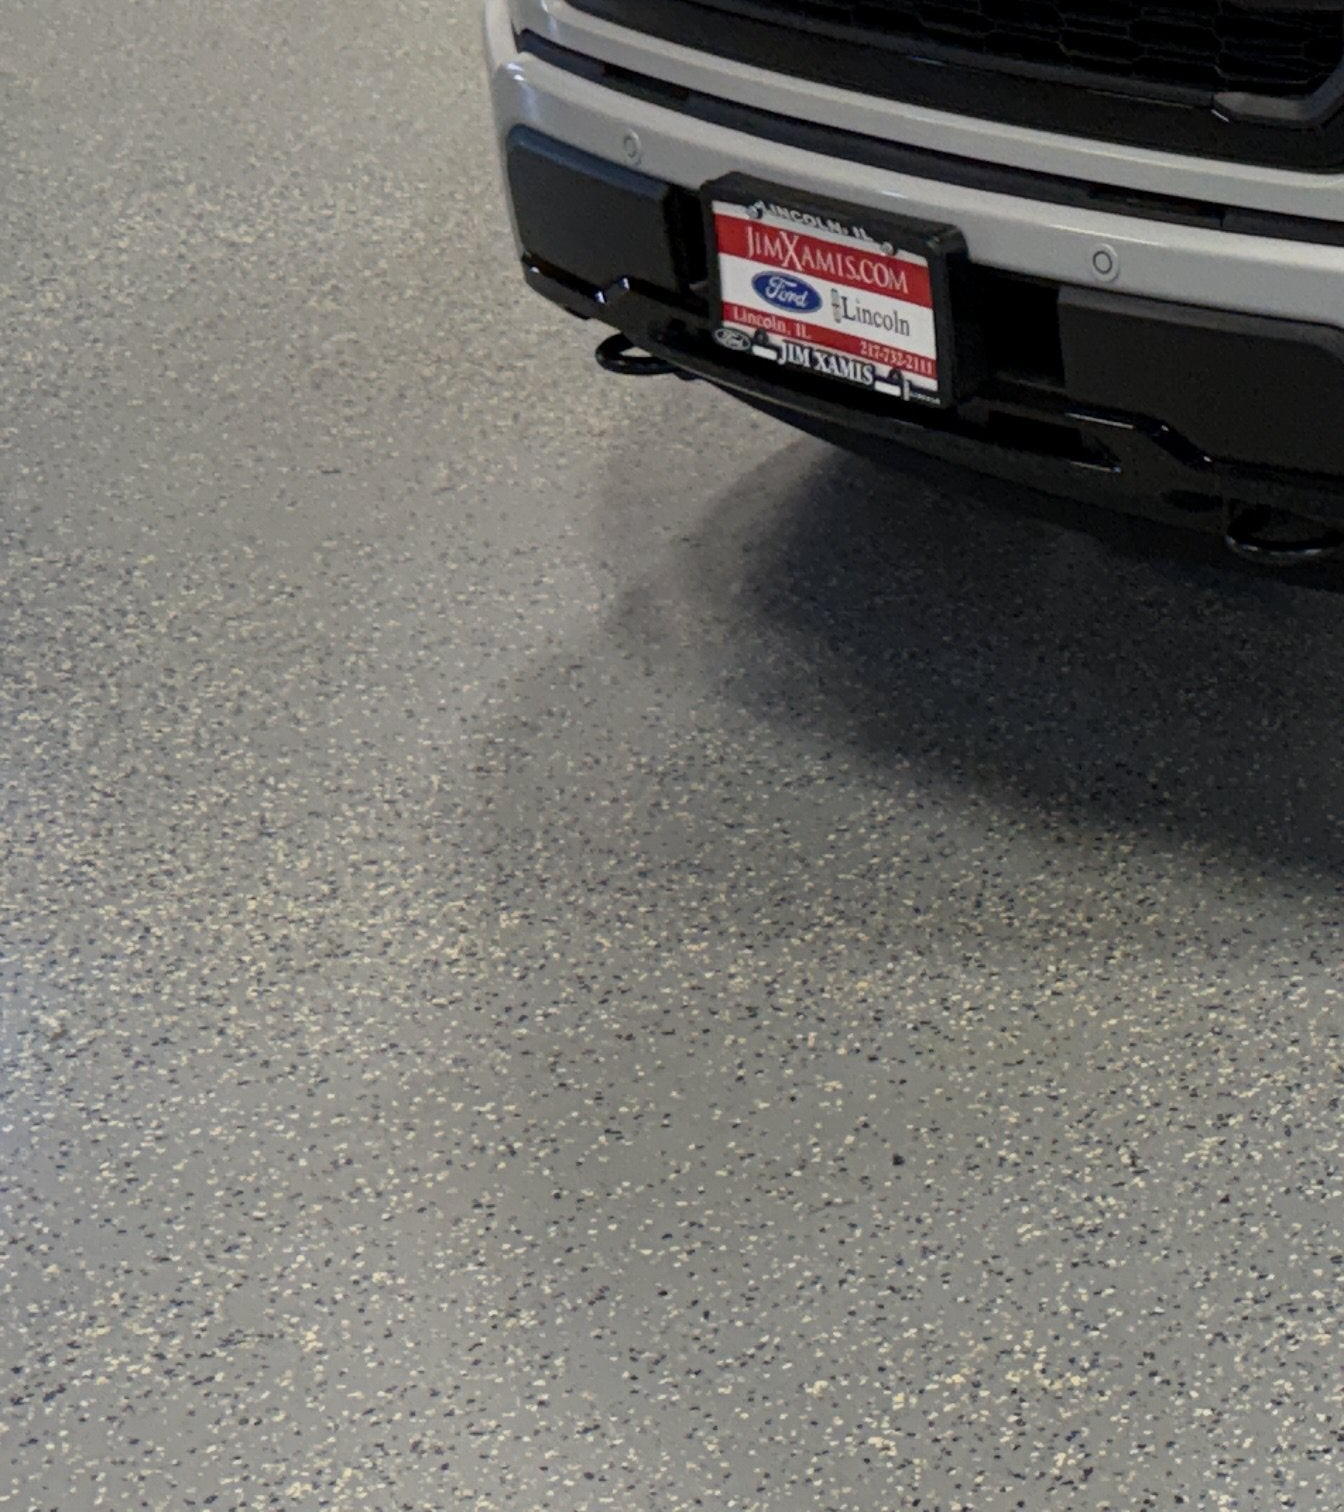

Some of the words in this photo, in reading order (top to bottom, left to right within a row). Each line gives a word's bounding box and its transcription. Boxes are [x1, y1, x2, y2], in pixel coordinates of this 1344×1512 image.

[765, 275, 809, 309] Ford
[842, 296, 911, 337] Lincoln
[777, 341, 813, 368] JIM
[813, 349, 875, 386] XAMIS
